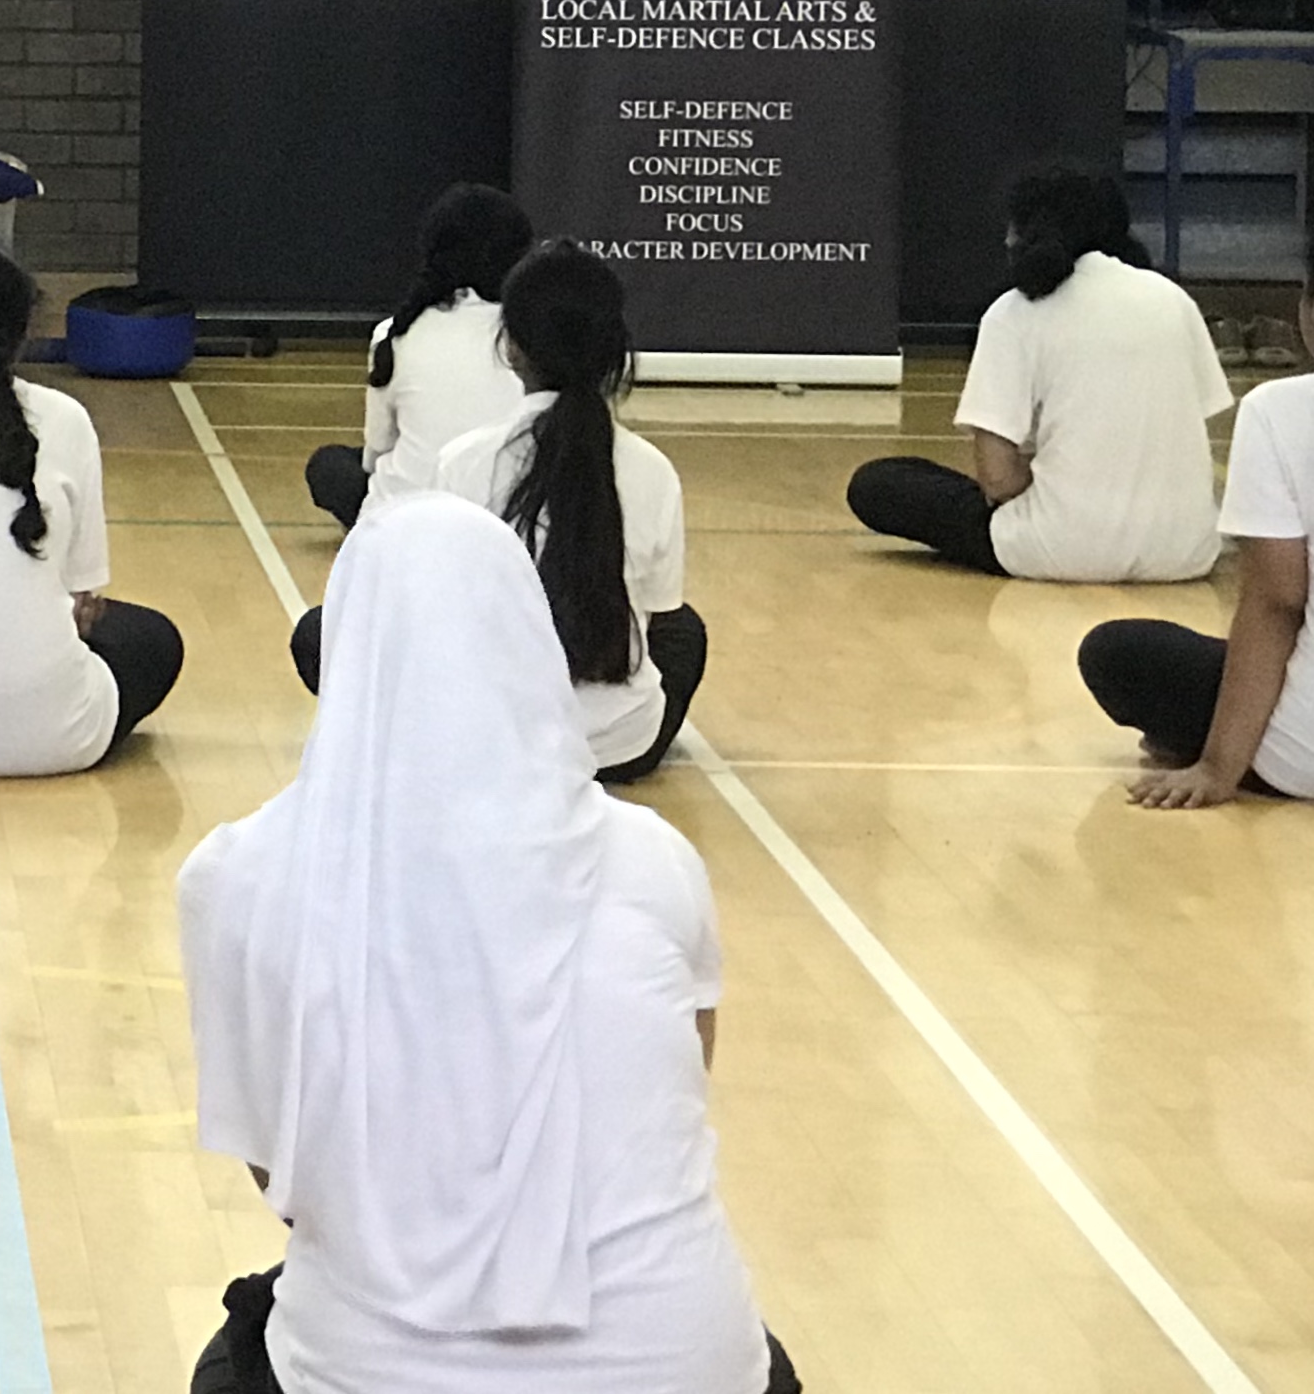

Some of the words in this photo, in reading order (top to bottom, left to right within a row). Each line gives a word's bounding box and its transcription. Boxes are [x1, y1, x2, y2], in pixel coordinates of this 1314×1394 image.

[642, 0, 771, 22] MARTIAL
[774, 0, 847, 23] ARTS
[854, 0, 877, 23] &
[540, 26, 745, 50] SELF-DEFENCE
[752, 27, 876, 51] CLASSES
[619, 100, 793, 121] SELF-DEFENCE
[658, 128, 754, 148] FITNESS
[628, 156, 782, 177] CONFIDENCE
[639, 184, 770, 205] DISCIPLINE
[666, 212, 744, 233] FOCUS
[578, 240, 685, 260] RACTER
[691, 241, 871, 262] DEVELOPMENT
